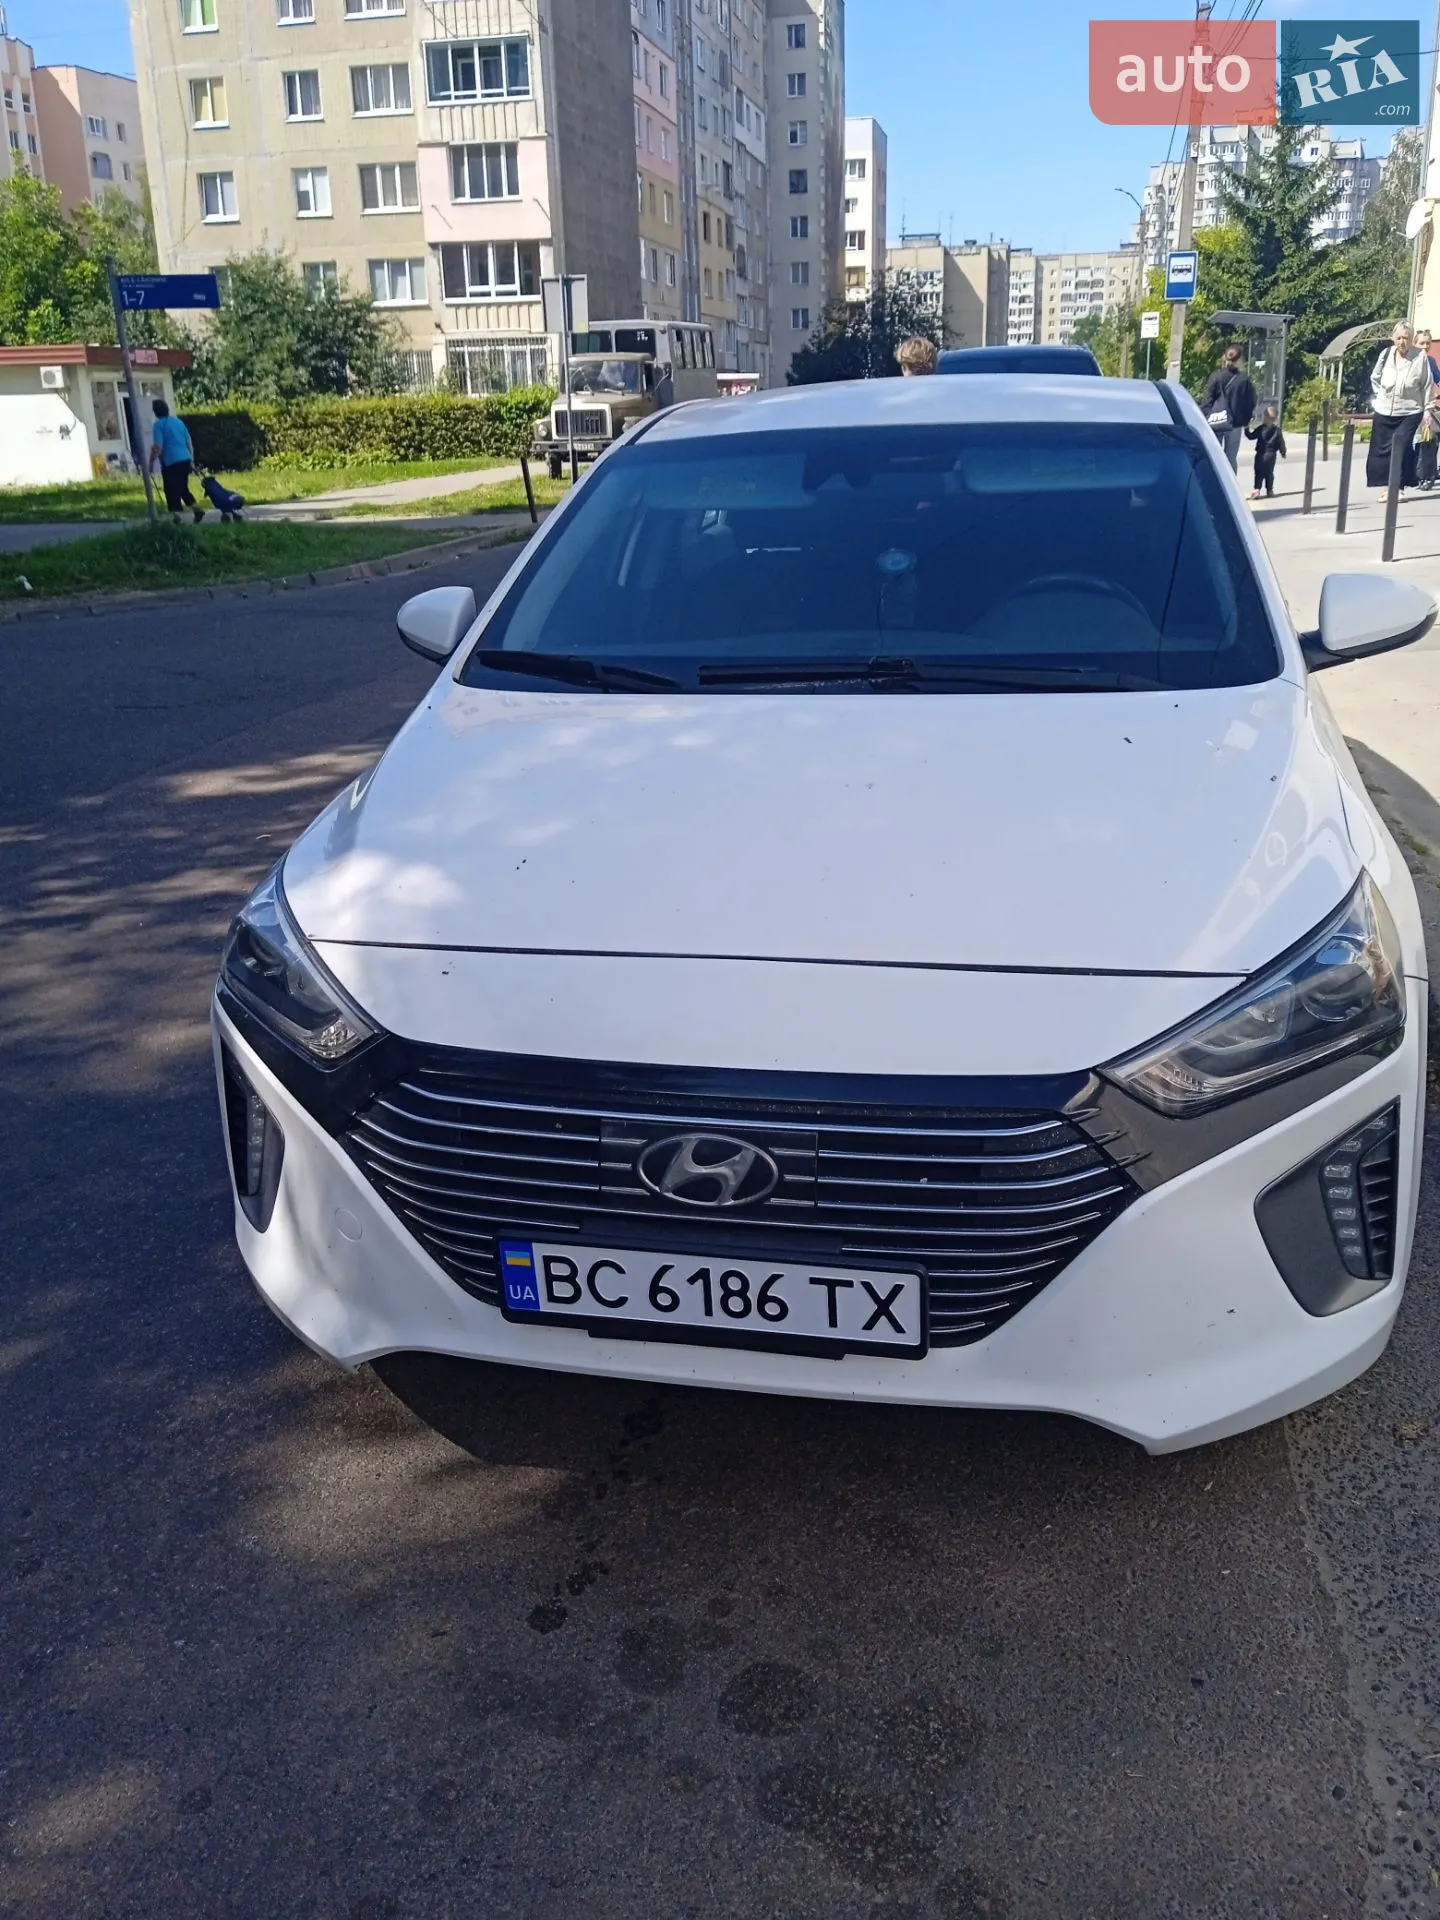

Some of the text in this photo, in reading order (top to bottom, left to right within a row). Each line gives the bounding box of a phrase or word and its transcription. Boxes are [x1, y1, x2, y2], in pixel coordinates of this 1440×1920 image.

[509, 1284, 536, 1301] UA
[542, 1254, 907, 1335] BC 6186 TX
